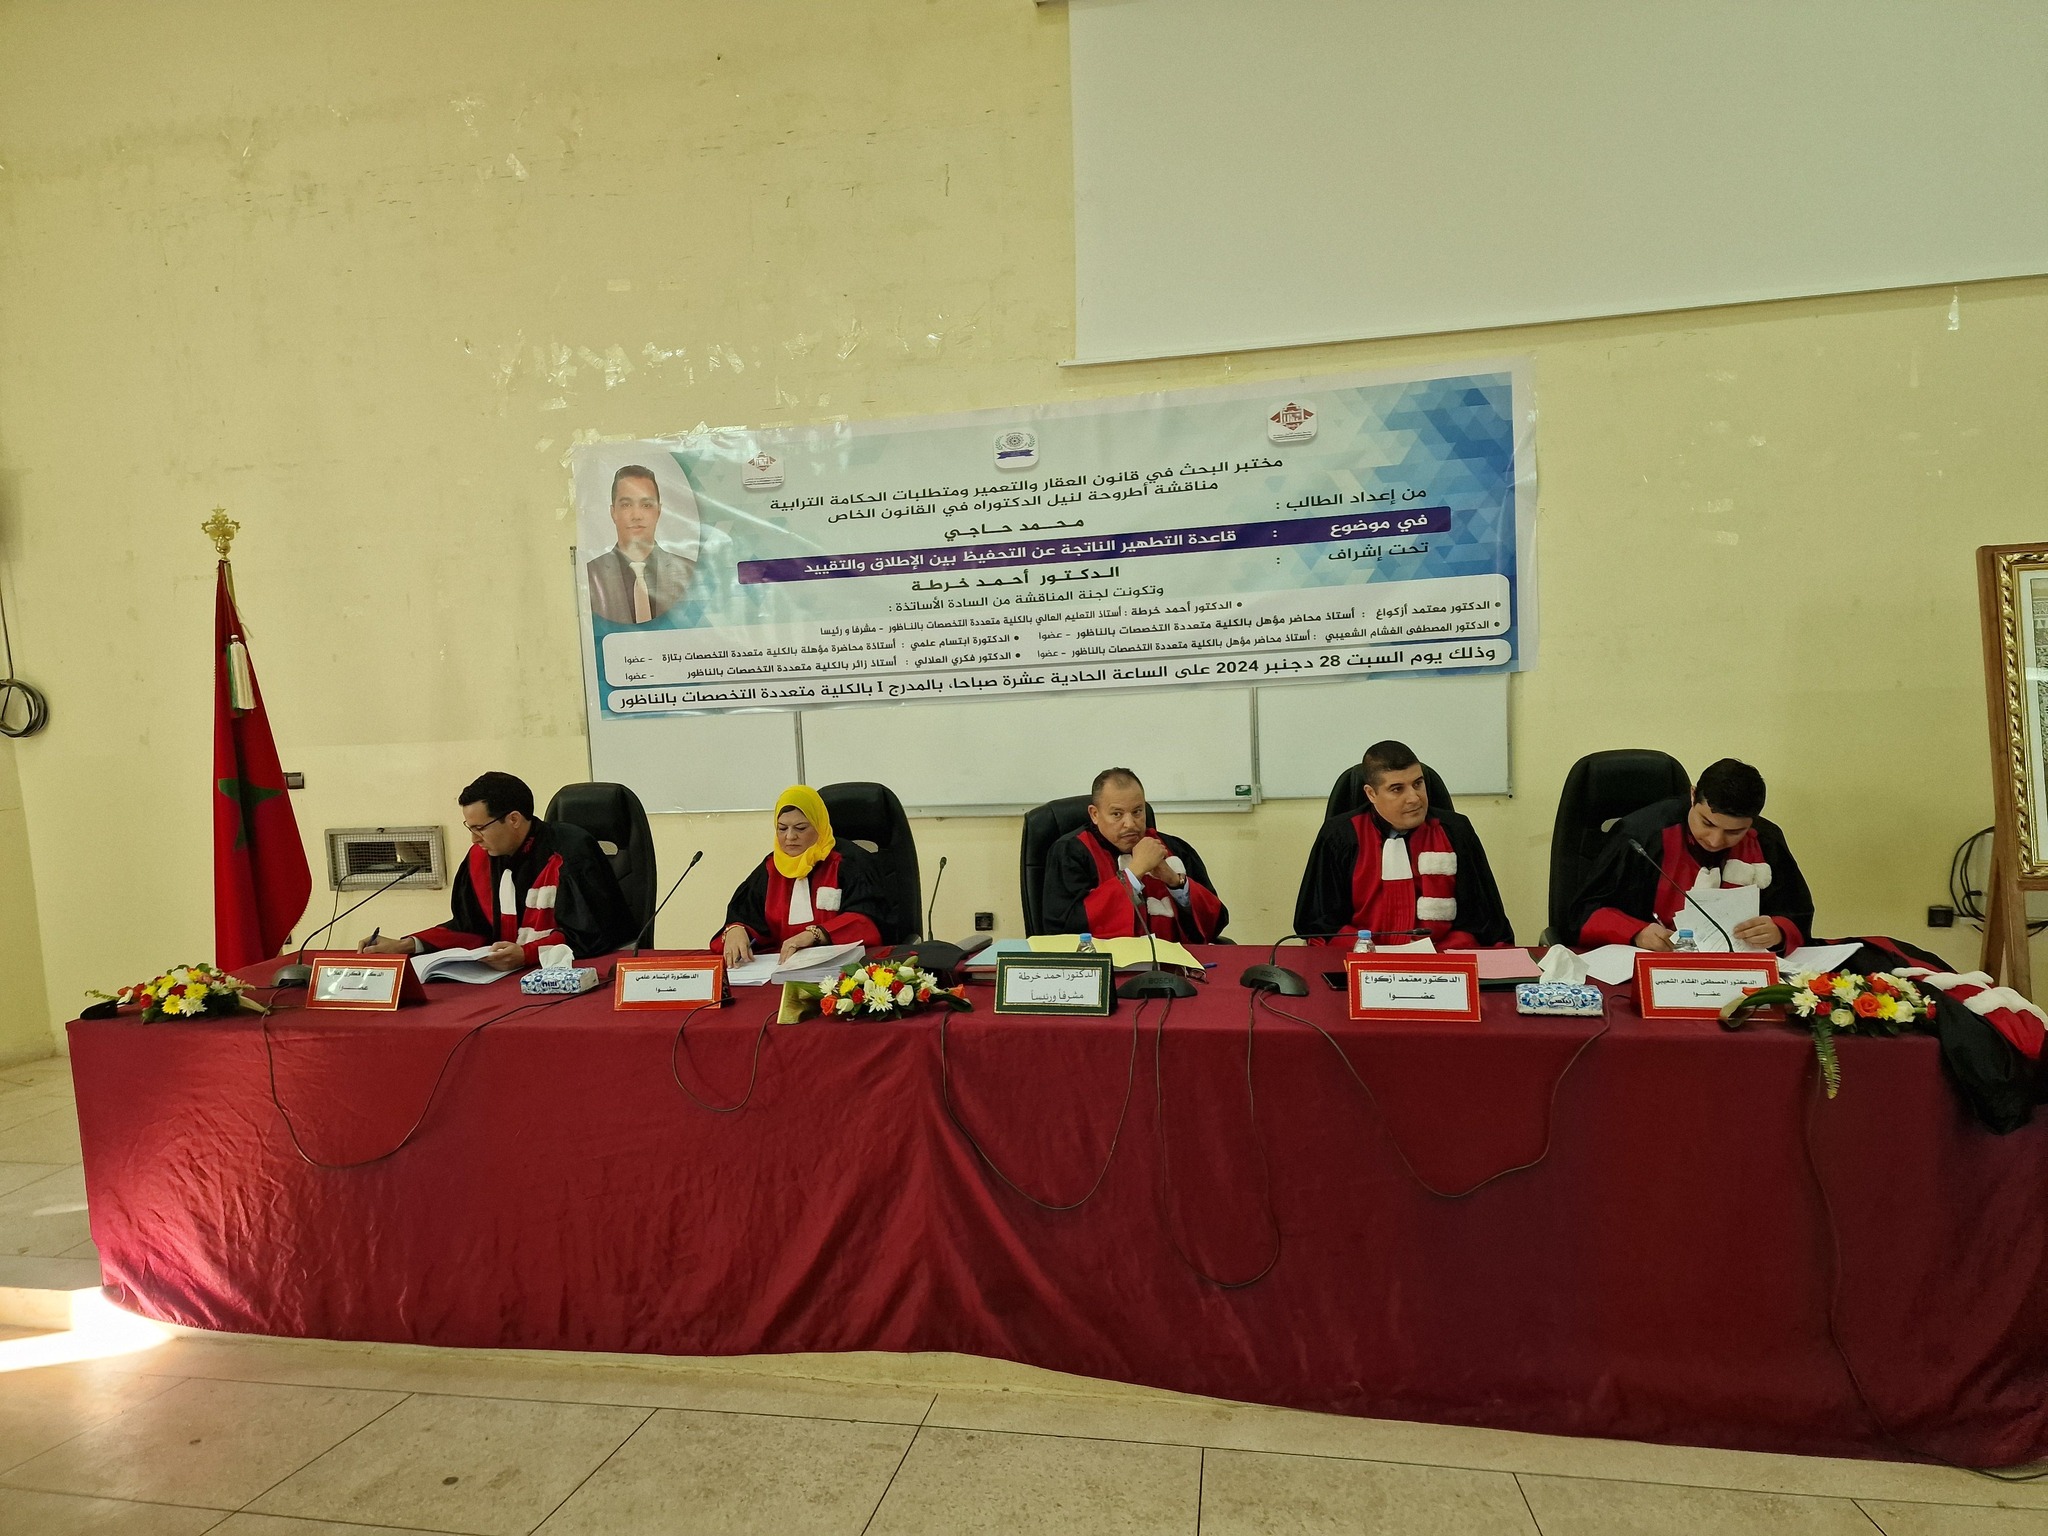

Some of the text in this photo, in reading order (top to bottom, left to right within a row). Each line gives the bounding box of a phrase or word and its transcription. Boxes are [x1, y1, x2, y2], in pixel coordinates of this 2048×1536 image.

[770, 458, 1283, 511] مختبر البحث في قانون العقار والتعمير ومتطلبات الحكامة الترابية
[1350, 489, 1396, 505] إعداد
[1402, 489, 1426, 501] من
[828, 480, 1218, 523] مناقشة أطروحة لنيل الدكتوراه في القانون الخاص
[1286, 493, 1342, 511] الطالب
[1330, 520, 1390, 537] موضوع
[1397, 514, 1427, 532] في
[944, 519, 1084, 542] محمد حاجي
[1188, 530, 1236, 544] قاعدة
[1061, 540, 1115, 556] الناتجة
[1120, 534, 1183, 553] التطهير
[1388, 542, 1429, 555] تحت
[963, 547, 1026, 563] التحفيظ
[1032, 547, 1055, 559] عن
[1328, 544, 1383, 562] إشراف
[870, 554, 924, 571] الإطلاق
[929, 555, 956, 566] بين
[804, 559, 865, 575] والتقييد
[912, 566, 1119, 592] الدكتور أحمد خرطة
[1015, 591, 1073, 604] المناقشة
[1078, 588, 1108, 601] لجنة
[1113, 585, 1164, 598] وتكونت
[896, 597, 944, 611] الأساتذة
[948, 597, 988, 608] السادة
[993, 597, 1010, 607] من
[1165, 601, 1190, 613] أحمد
[1194, 601, 1232, 614] الدكتور
[1450, 601, 1490, 614] الدكتور
[1098, 606, 1121, 618] أستاذ
[1131, 606, 1161, 617] خرطة
[1325, 607, 1354, 620] أستاذ
[1376, 603, 1407, 620] أزكواغ
[1412, 605, 1447, 614] معتمد
[970, 617, 1000, 626] متعددة
[1003, 615, 1032, 626] بالكلية
[1035, 613, 1062, 626] العالي
[1065, 611, 1095, 622] التعليم
[1256, 615, 1285, 627] مؤهل
[1289, 614, 1321, 625] محاضر
[852, 623, 876, 635] مشرفا
[888, 622, 924, 633] بالناظور
[926, 619, 967, 629] التخصصات
[1119, 623, 1170, 634] التخصصات
[1174, 621, 1211, 631] متعددة
[1215, 618, 1252, 630] بالكلية
[1406, 623, 1452, 635] المصطفى
[1455, 620, 1489, 633] الدكتور
[820, 626, 842, 637] رئيسا
[845, 628, 849, 636] و
[1039, 631, 1062, 641] عضوا
[1076, 627, 1116, 639] بالناظور
[1285, 629, 1310, 642] أستاذ
[1325, 627, 1366, 643] الشعيبي
[1370, 625, 1403, 638] الغشام
[866, 638, 896, 650] أستاذة
[910, 639, 936, 651] علمي
[939, 637, 970, 648] ابتسام
[973, 634, 1010, 646] الدكتورة
[1155, 641, 1188, 650] متعددة
[1191, 638, 1222, 650] بالكلية
[1226, 636, 1251, 648] مؤهل
[1254, 635, 1282, 646] محاضر
[731, 649, 763, 658] متعددة
[766, 647, 798, 658] بالكلية
[801, 645, 829, 655] مؤهلة
[831, 643, 863, 654] محاضرة
[1072, 646, 1105, 658] بالناظور
[1108, 643, 1152, 653] التخصصات
[624, 656, 645, 665] عضوا
[662, 653, 682, 663] بتازة
[685, 650, 729, 660] التخصصات
[951, 654, 975, 666] فكري
[978, 652, 1011, 663] الدكتور
[1037, 650, 1058, 659] عضوا
[815, 661, 849, 672] بالكلية
[852, 660, 867, 670] زائر
[871, 655, 897, 667] أستاذ
[914, 656, 948, 668] العلالي
[687, 668, 723, 679] بالناظور
[727, 665, 774, 675] التخصصات
[777, 663, 812, 672] متعددة
[620, 646, 1495, 709] وذلك يوم السبت 28 دجنبر 2024 على الساعة الحادية عشرة صباحا، بالمدرج I بالكلية متعددة التخصصات بالناظور
[625, 673, 646, 682] عضوا
[1364, 973, 1461, 985] الدكتور معتمد أزكواغ
[1389, 992, 1436, 1001] عضوا
